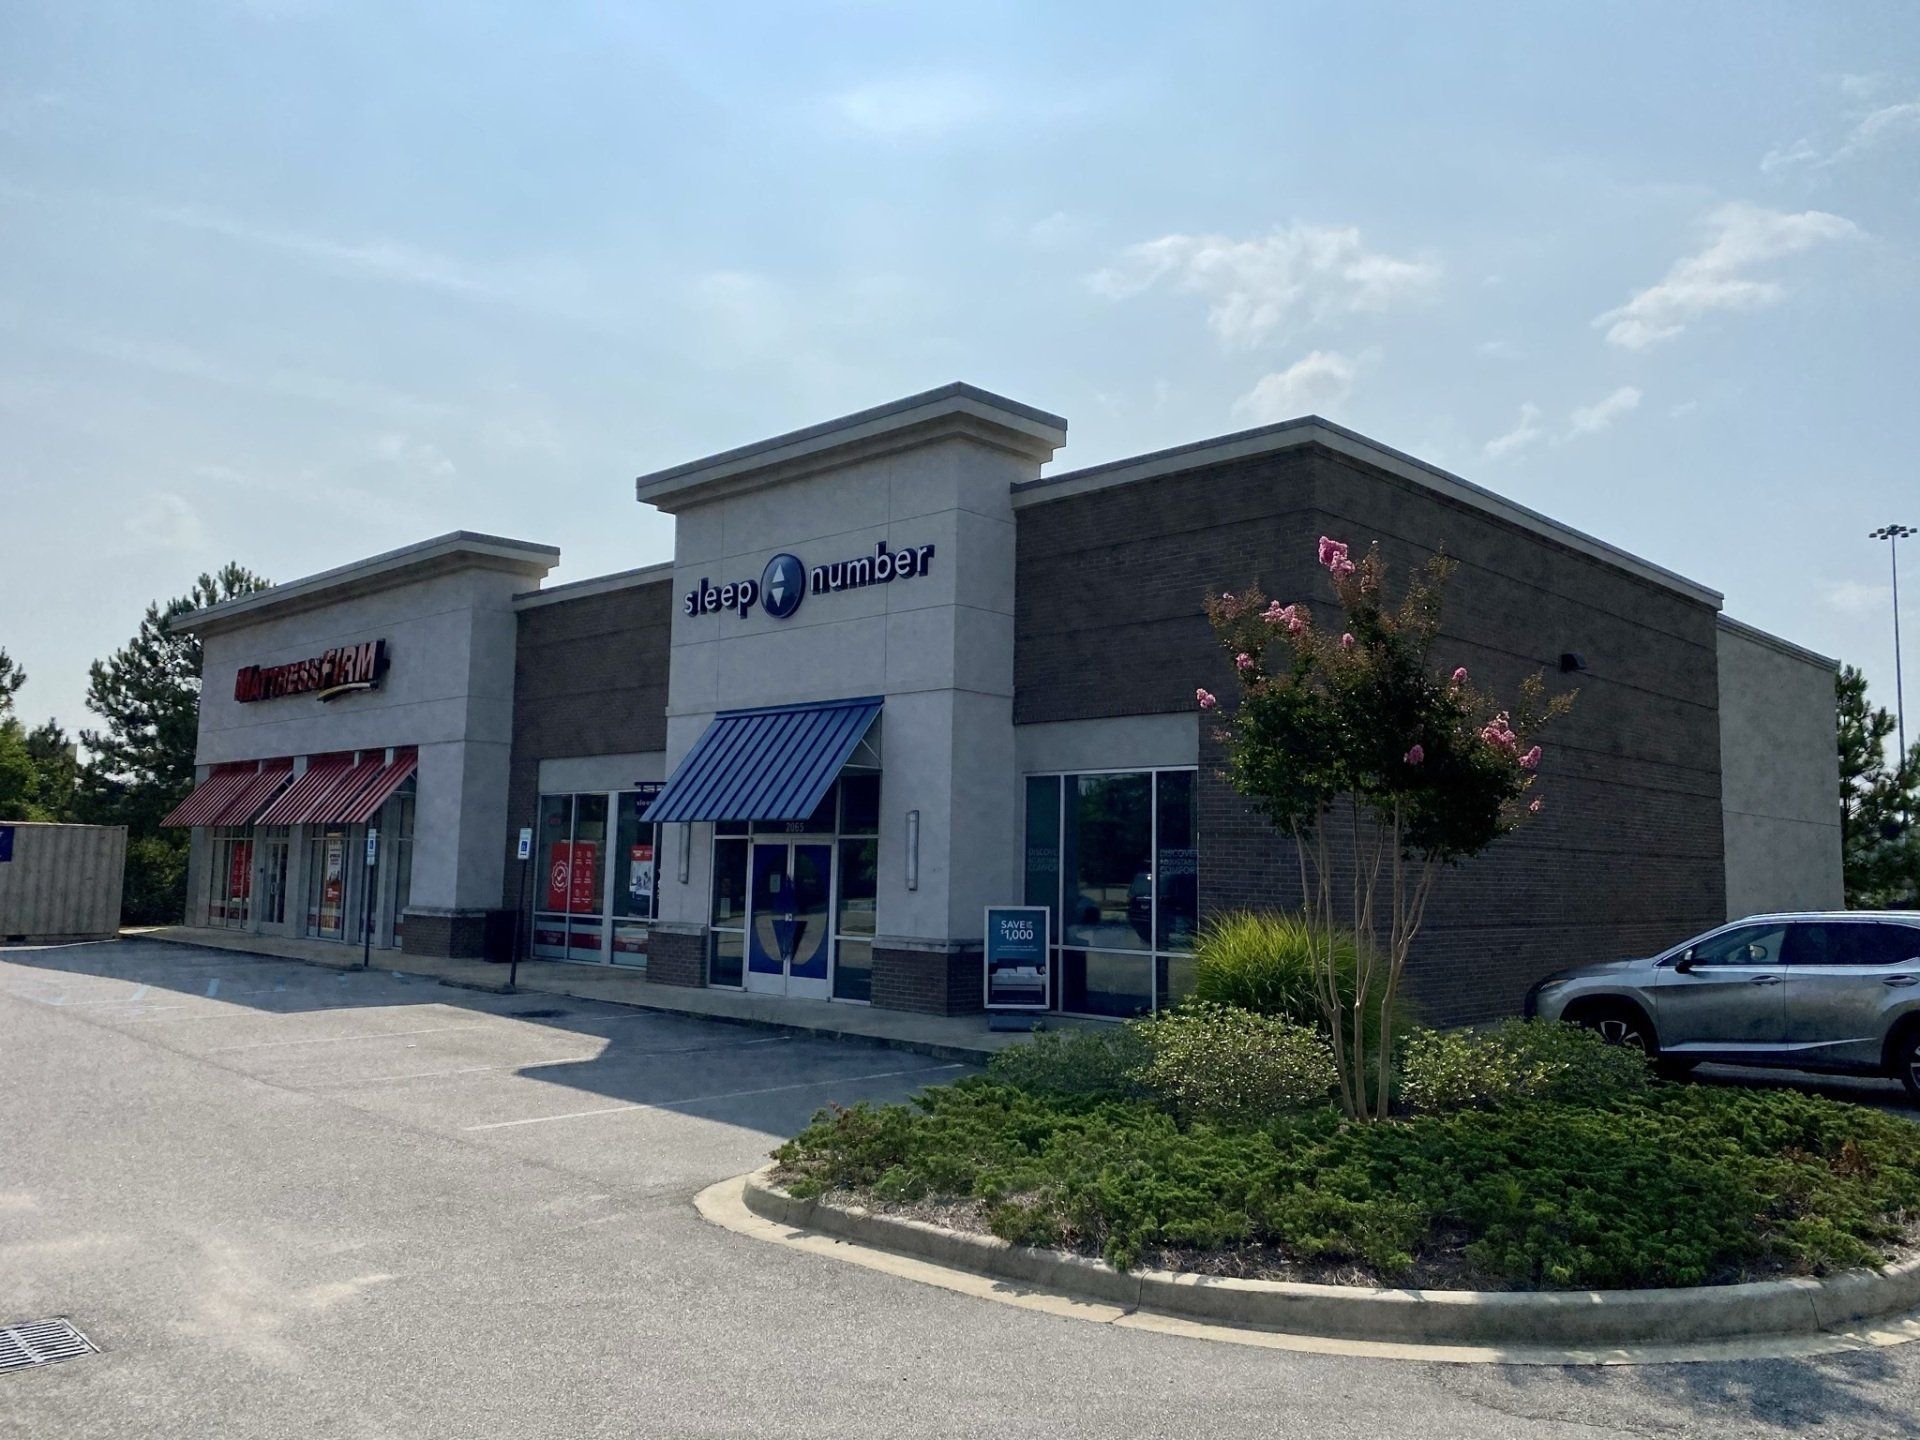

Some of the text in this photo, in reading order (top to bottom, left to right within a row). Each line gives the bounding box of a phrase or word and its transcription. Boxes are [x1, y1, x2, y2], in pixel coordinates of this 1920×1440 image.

[683, 540, 936, 619] sleep number
[785, 821, 805, 833] 2065
[1001, 920, 1026, 929] SAVE
[1000, 929, 1034, 941] $1,000
